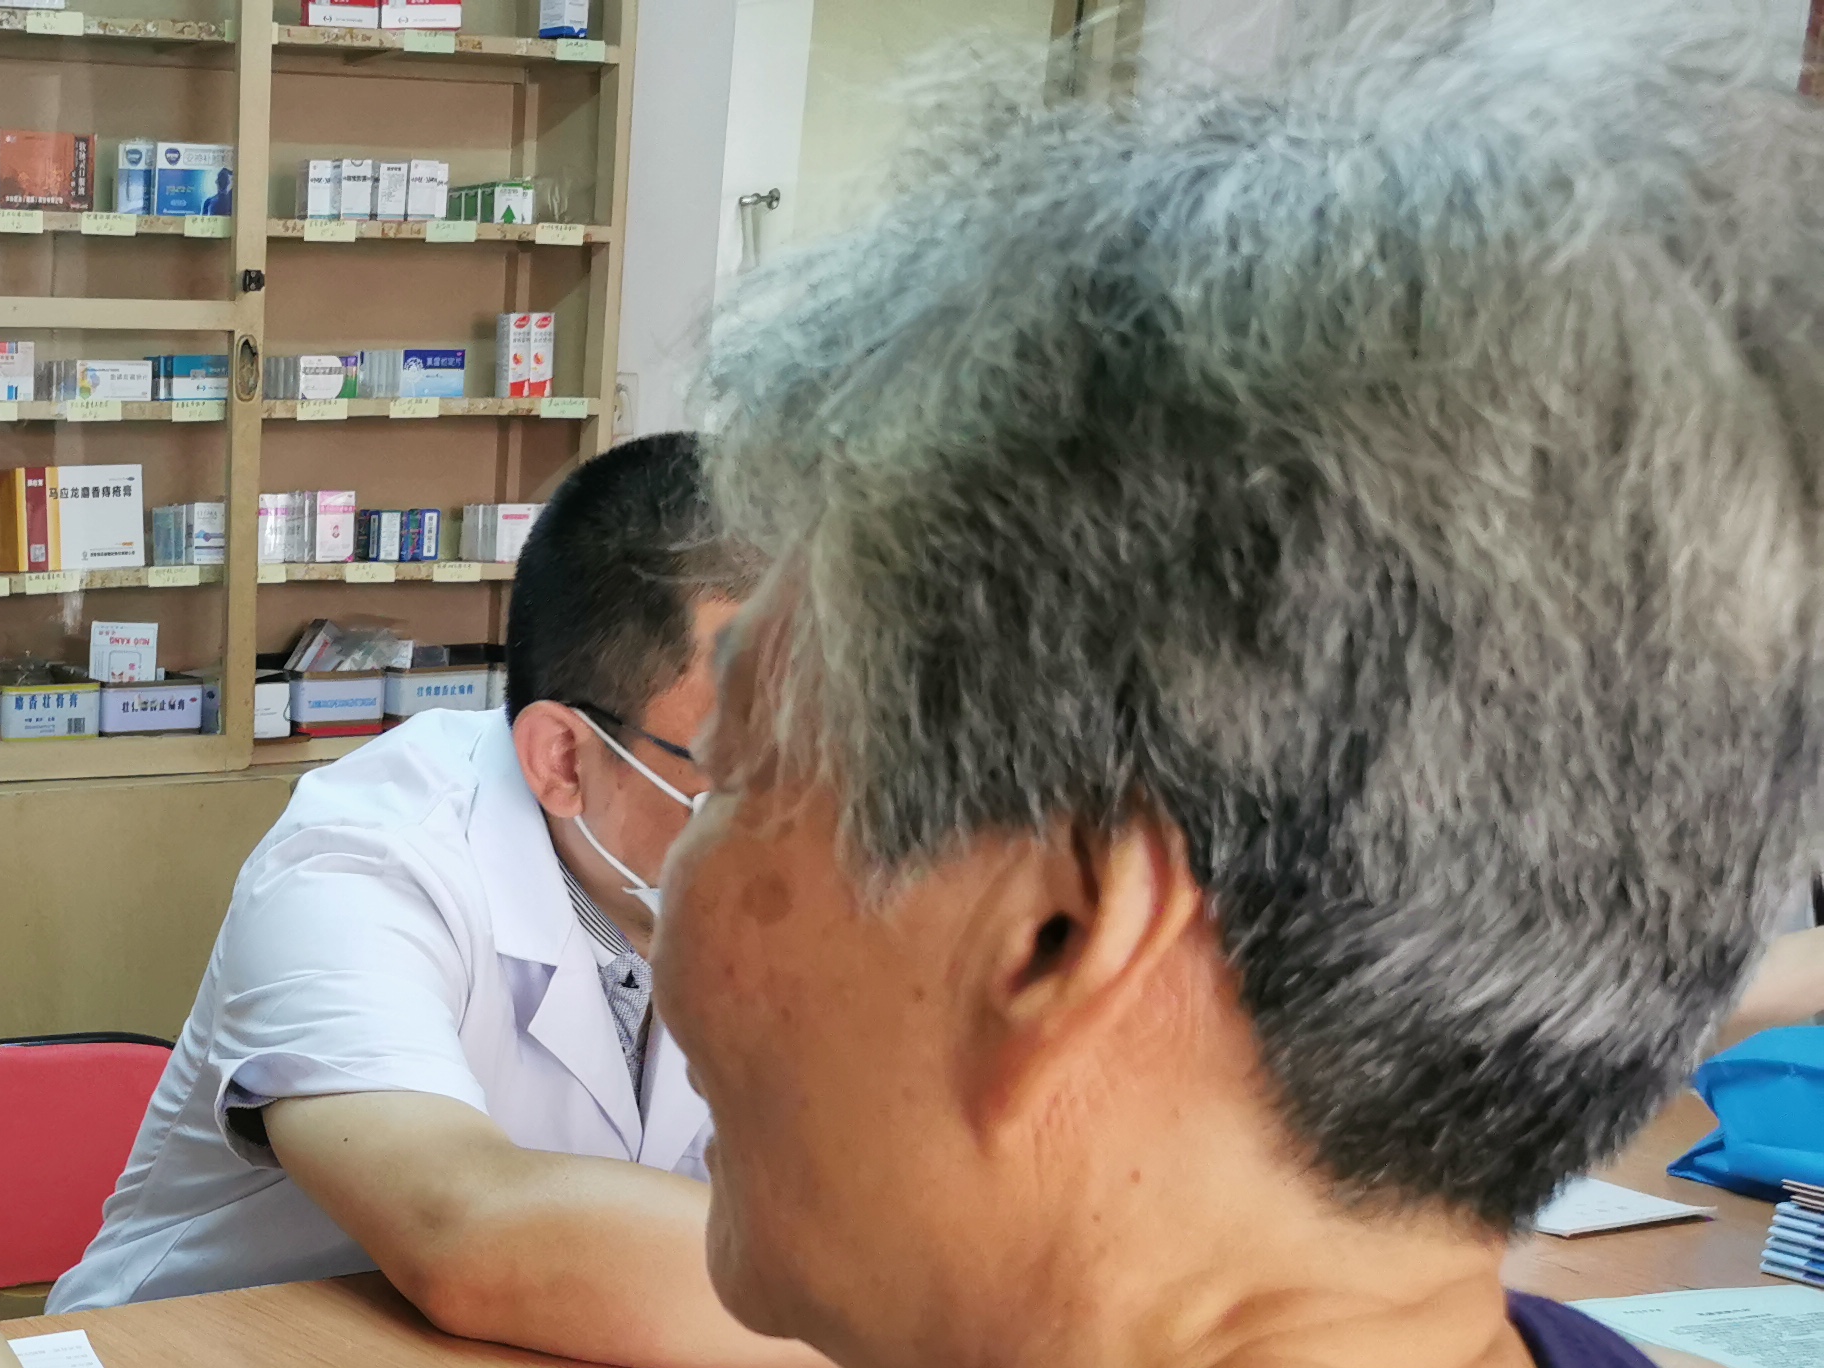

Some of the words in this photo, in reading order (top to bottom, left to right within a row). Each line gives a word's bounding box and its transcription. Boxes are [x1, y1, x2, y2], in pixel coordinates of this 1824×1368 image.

[49, 485, 132, 499] 马应龙麝香痔疮膏
[15, 693, 78, 711] 麝香壮骨膏
